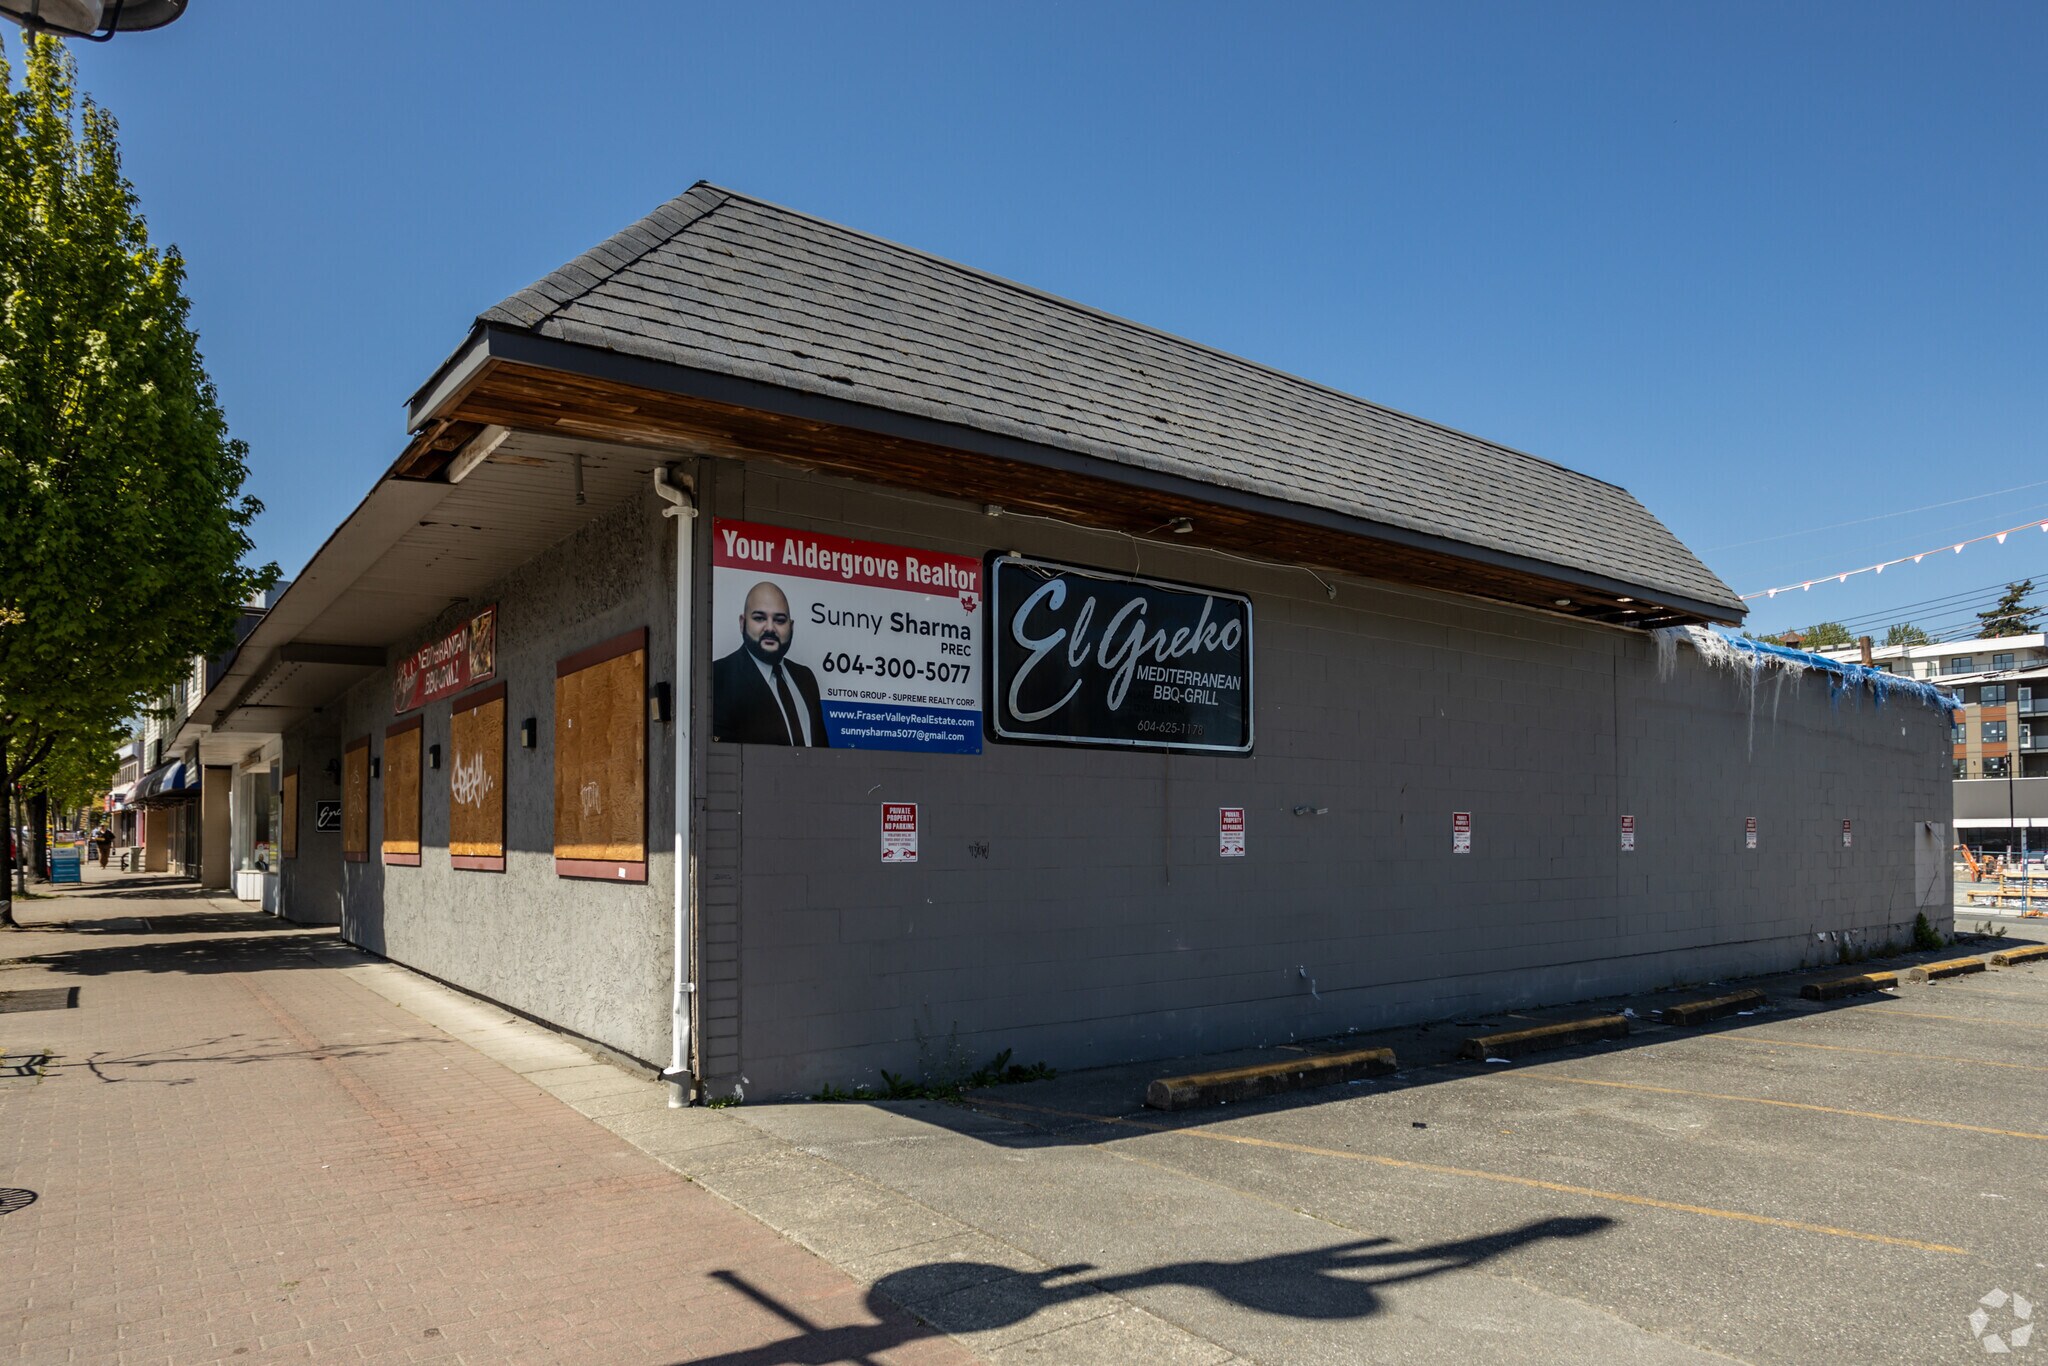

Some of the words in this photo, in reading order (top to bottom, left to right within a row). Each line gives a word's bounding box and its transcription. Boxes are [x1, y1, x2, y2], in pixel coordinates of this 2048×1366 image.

[721, 528, 775, 562] Your
[782, 538, 899, 580] Aldergrove
[905, 556, 977, 591] Realtor
[811, 602, 883, 635] Sunny
[890, 612, 971, 641] Sharma
[941, 642, 972, 657] PREC
[1008, 579, 1096, 722] El
[1098, 595, 1242, 711] Greko
[822, 652, 971, 684] 604-300-5077
[1136, 664, 1242, 691] MEDITERRANEAN
[827, 688, 858, 698] SUTTON
[860, 690, 887, 700] GROUP
[892, 693, 927, 704] SUPREME
[928, 696, 955, 706] REALTY
[956, 698, 976, 707] CORP.
[1153, 684, 1219, 706] BBQ-GRILL
[829, 710, 975, 727] www.FraserValleyRealEstate.com
[840, 727, 965, 742] sunnysharma5077@gmail.com
